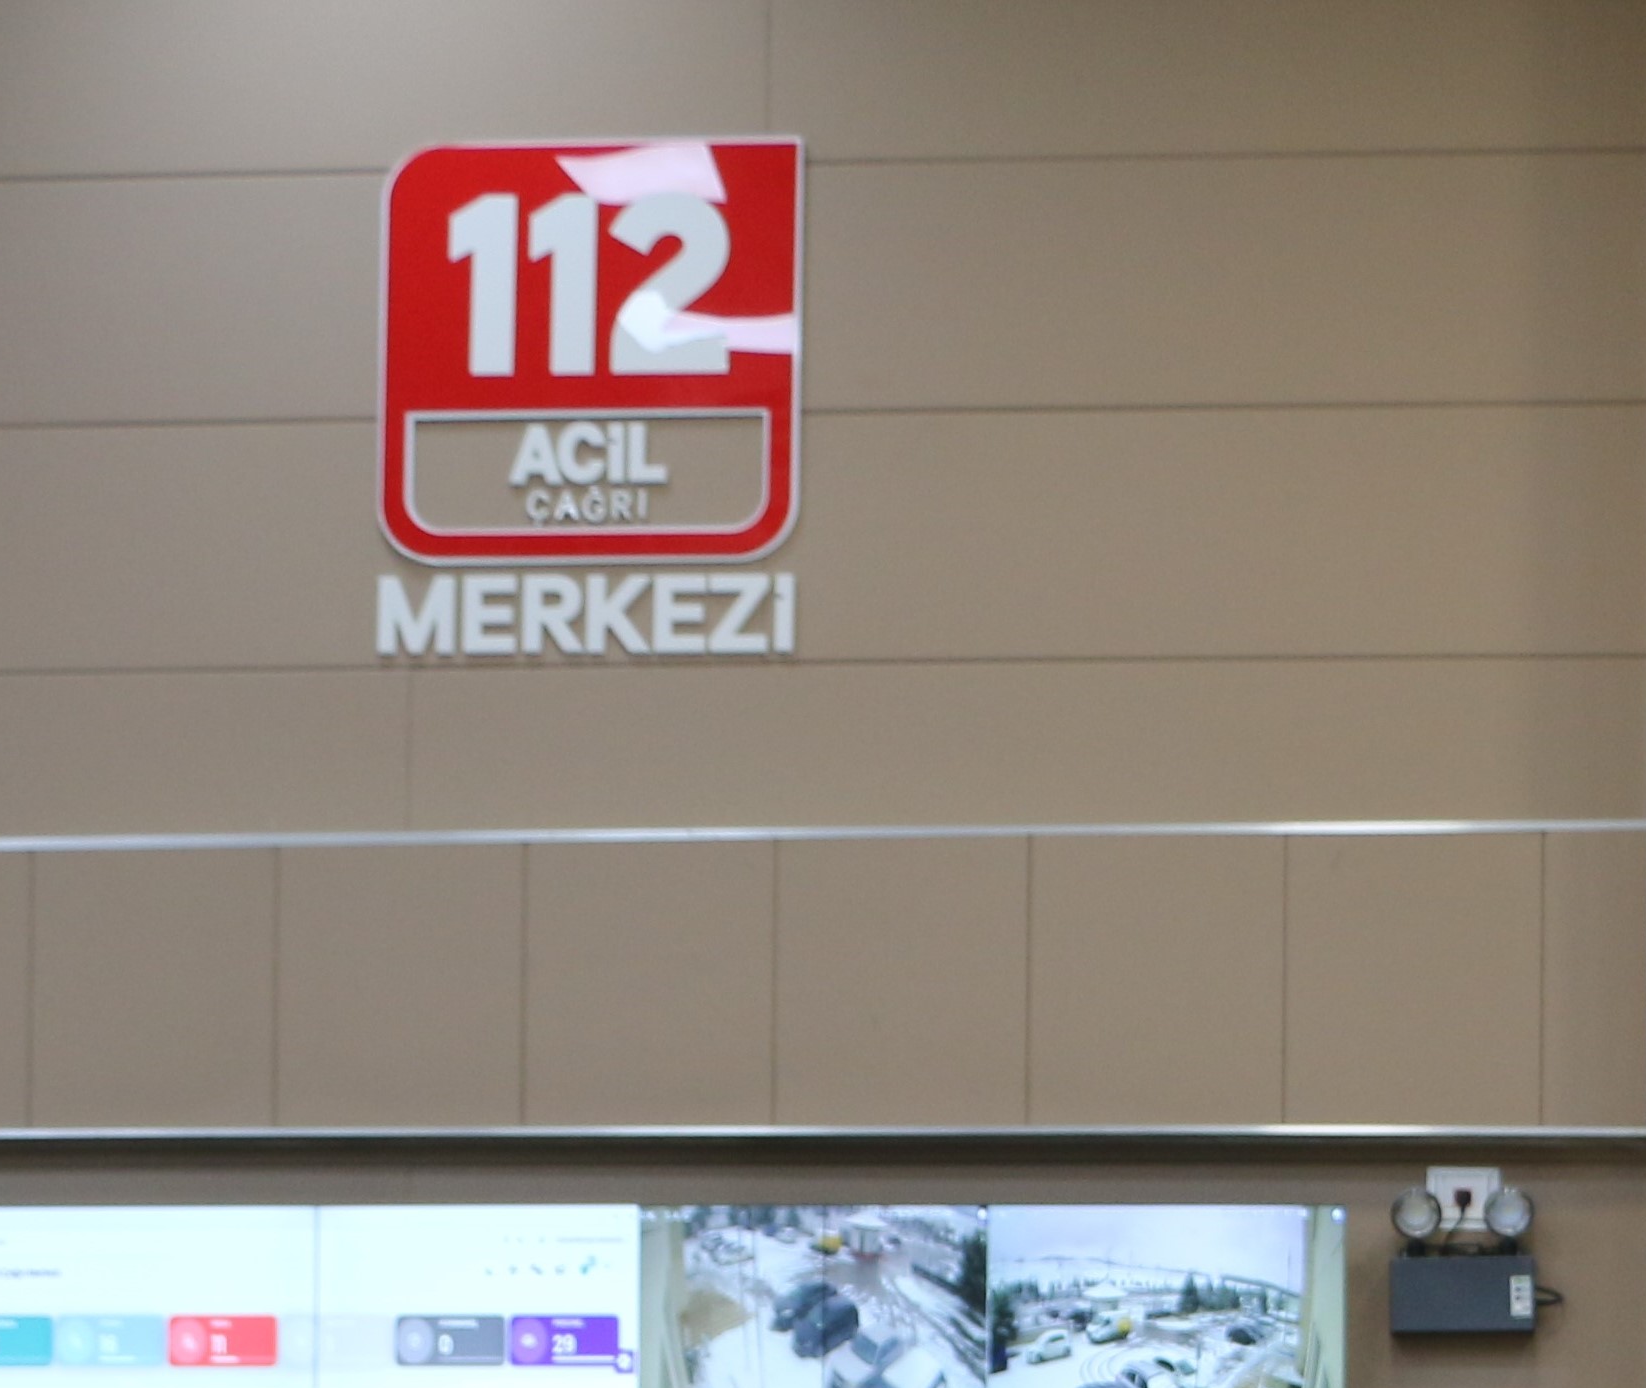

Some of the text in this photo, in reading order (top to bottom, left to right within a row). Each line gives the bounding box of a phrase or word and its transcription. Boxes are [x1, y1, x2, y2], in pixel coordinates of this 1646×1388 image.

[448, 191, 732, 378] 112
[508, 420, 669, 488] ACİL
[525, 485, 649, 527] ÇAĞRI
[375, 572, 796, 658] MERKEZİ
